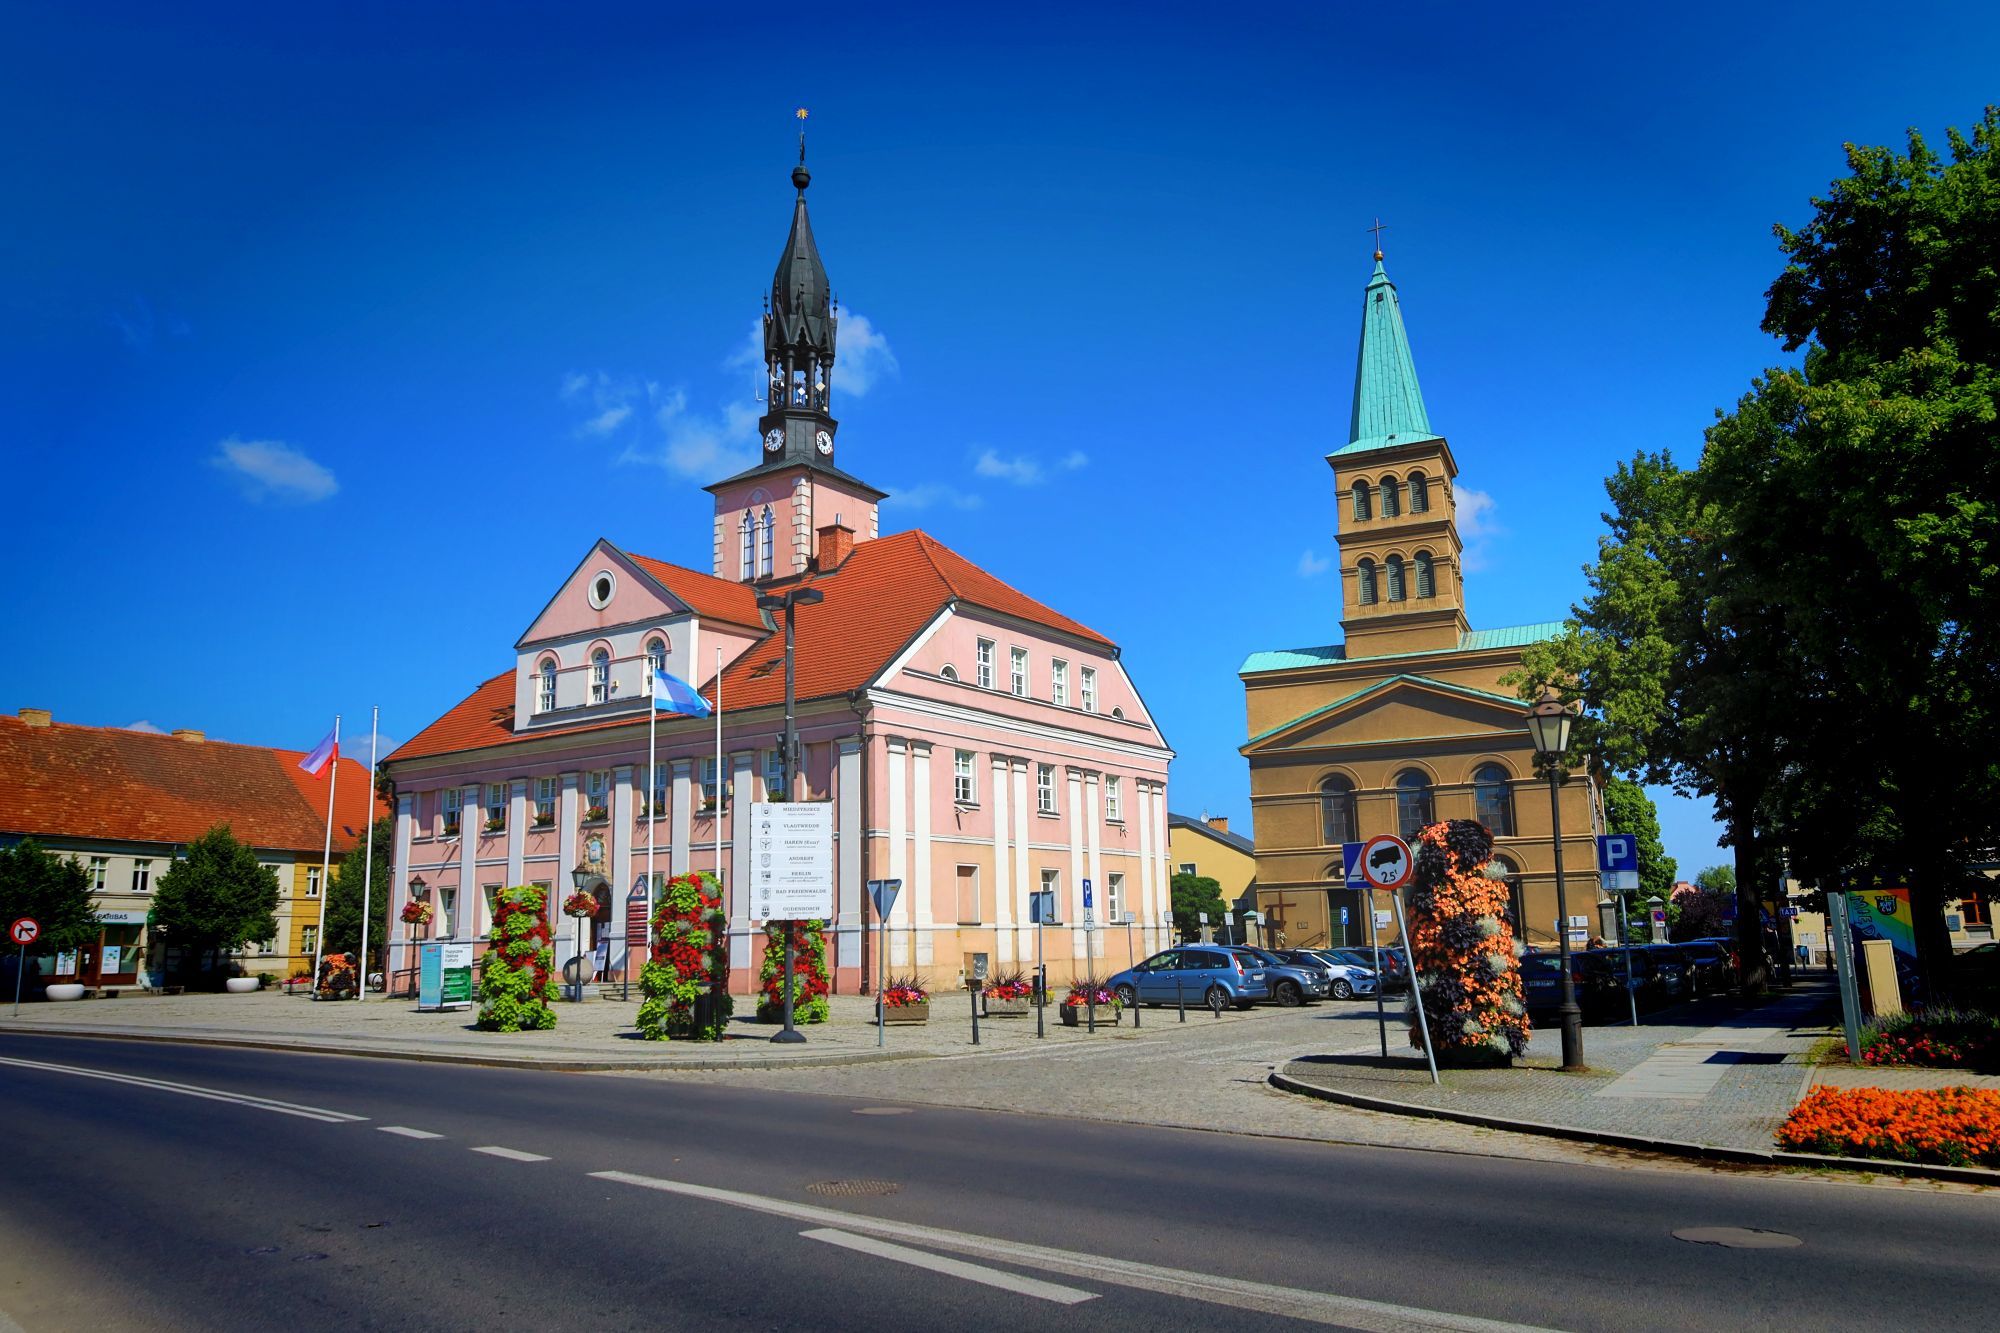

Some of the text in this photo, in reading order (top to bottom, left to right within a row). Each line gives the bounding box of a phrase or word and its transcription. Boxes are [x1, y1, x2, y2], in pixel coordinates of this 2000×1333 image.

[1606, 838, 1628, 867] P
[1084, 881, 1091, 899] P
[1342, 909, 1347, 922] P
[1780, 908, 1797, 916] TAXI
